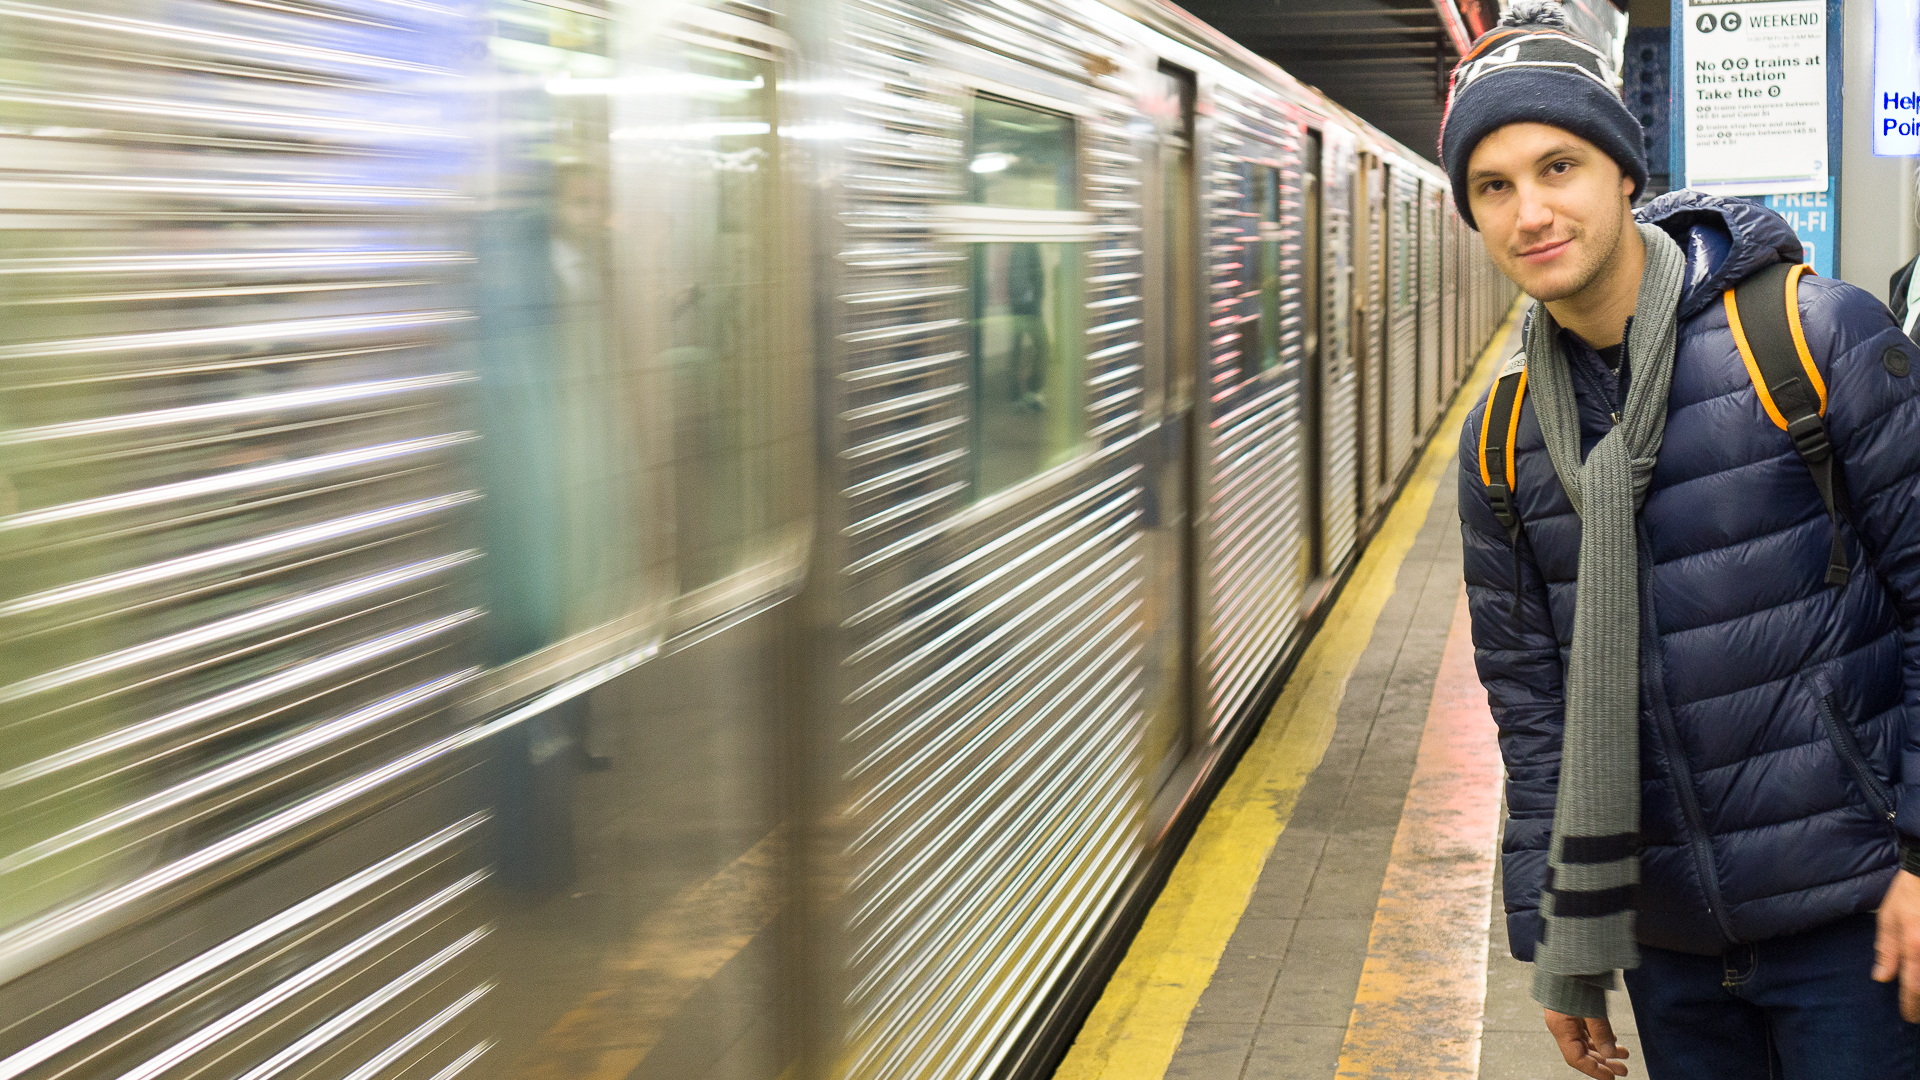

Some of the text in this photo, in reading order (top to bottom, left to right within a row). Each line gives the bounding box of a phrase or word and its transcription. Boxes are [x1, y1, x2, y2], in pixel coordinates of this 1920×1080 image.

[1698, 12, 1819, 33] A C WEEKEND
[1696, 61, 1716, 71] No
[1755, 55, 1800, 68] trains
[1805, 55, 1820, 66] at
[1696, 70, 1786, 84] this station
[1696, 88, 1732, 100] Take
[1738, 87, 1762, 98] the
[1772, 192, 1828, 207] FREE
